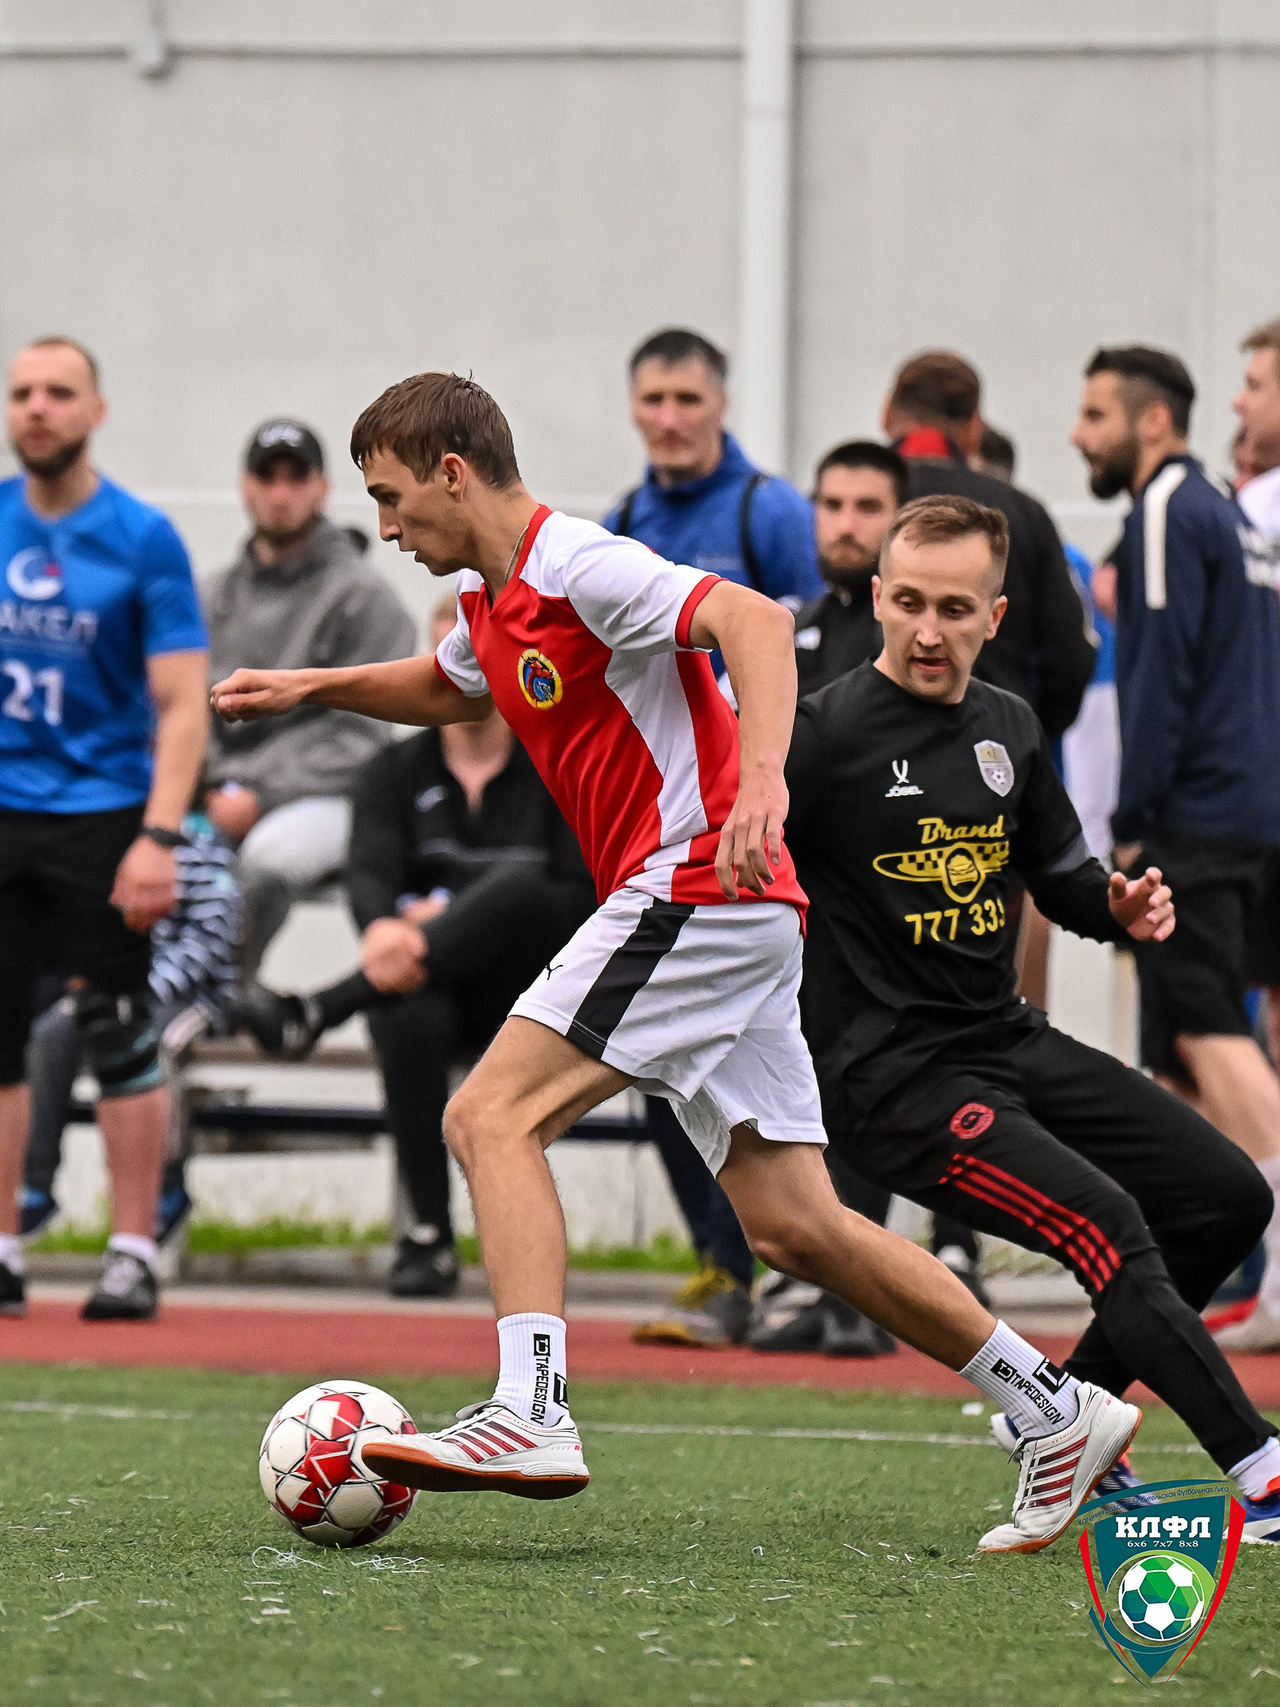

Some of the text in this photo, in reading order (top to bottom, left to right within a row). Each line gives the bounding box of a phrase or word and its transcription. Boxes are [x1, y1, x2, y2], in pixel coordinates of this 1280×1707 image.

[0, 660, 64, 725] 21
[917, 814, 1005, 845] Brand
[905, 908, 960, 945] 777
[530, 1356, 549, 1426] TAPEDESIGN
[1010, 1372, 1066, 1426] TAPEDESIGN
